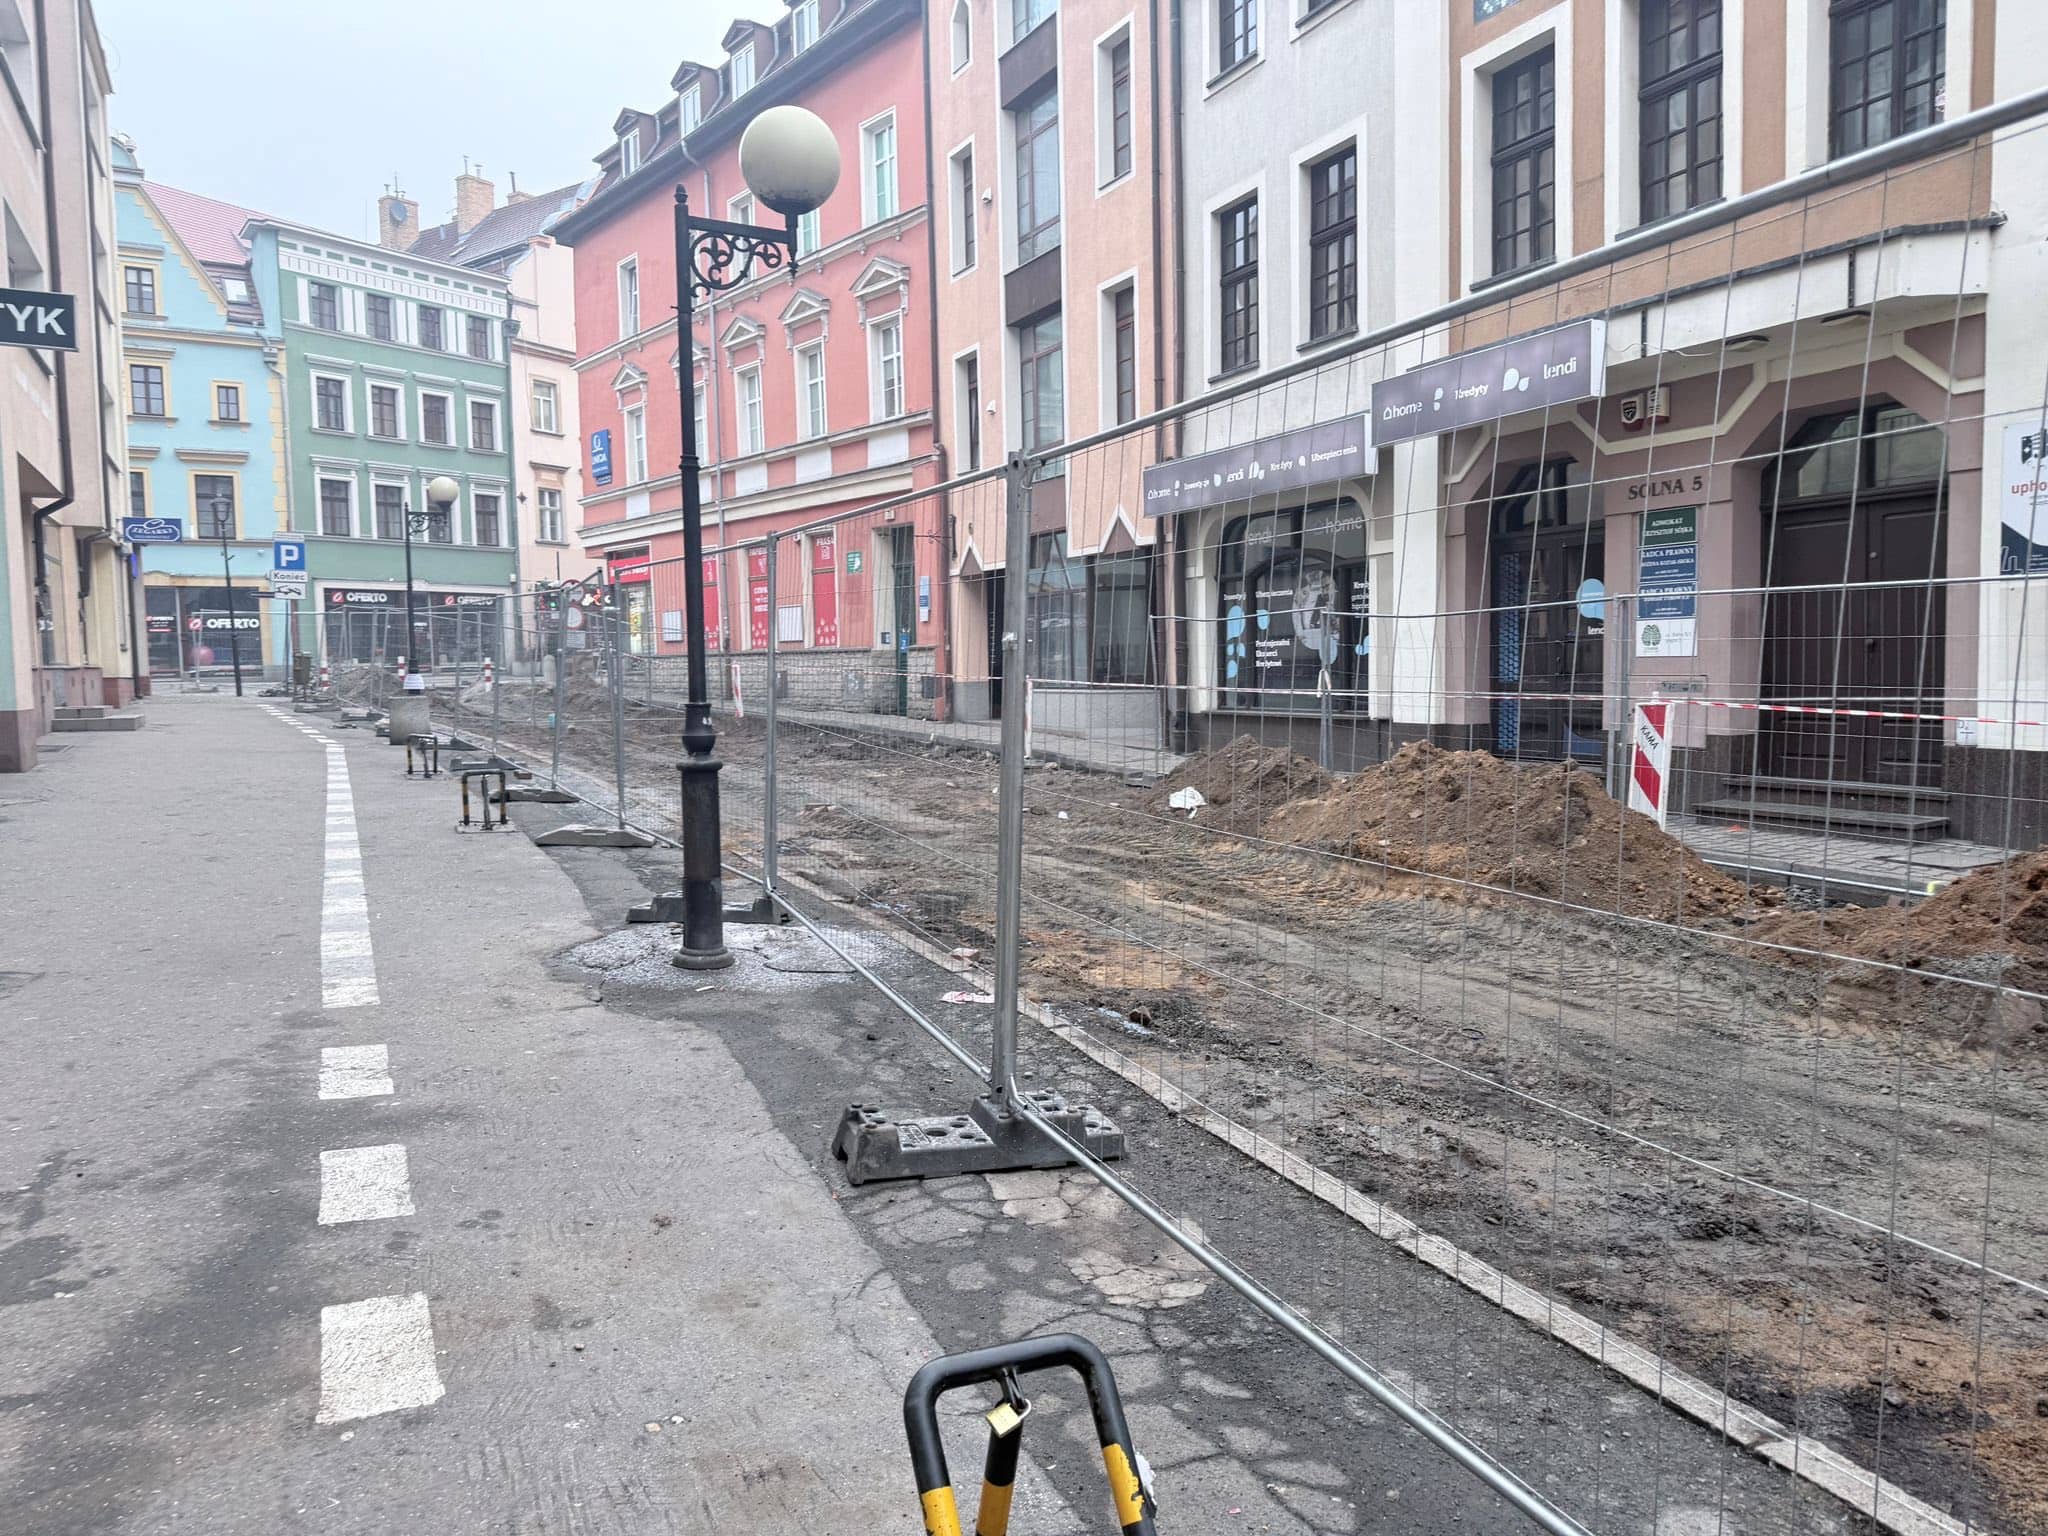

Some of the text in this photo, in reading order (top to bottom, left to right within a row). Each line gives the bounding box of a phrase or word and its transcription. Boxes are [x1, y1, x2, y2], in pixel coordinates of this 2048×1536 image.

[1392, 400, 1423, 418] home
[1543, 356, 1577, 380] lendi
[1628, 476, 1703, 500] SOLNA 5
[280, 545, 298, 566] P
[273, 572, 304, 580] Koniec
[346, 592, 388, 603] OFERTO
[206, 618, 260, 629] OFERTO
[1640, 725, 1660, 750] KAMA
